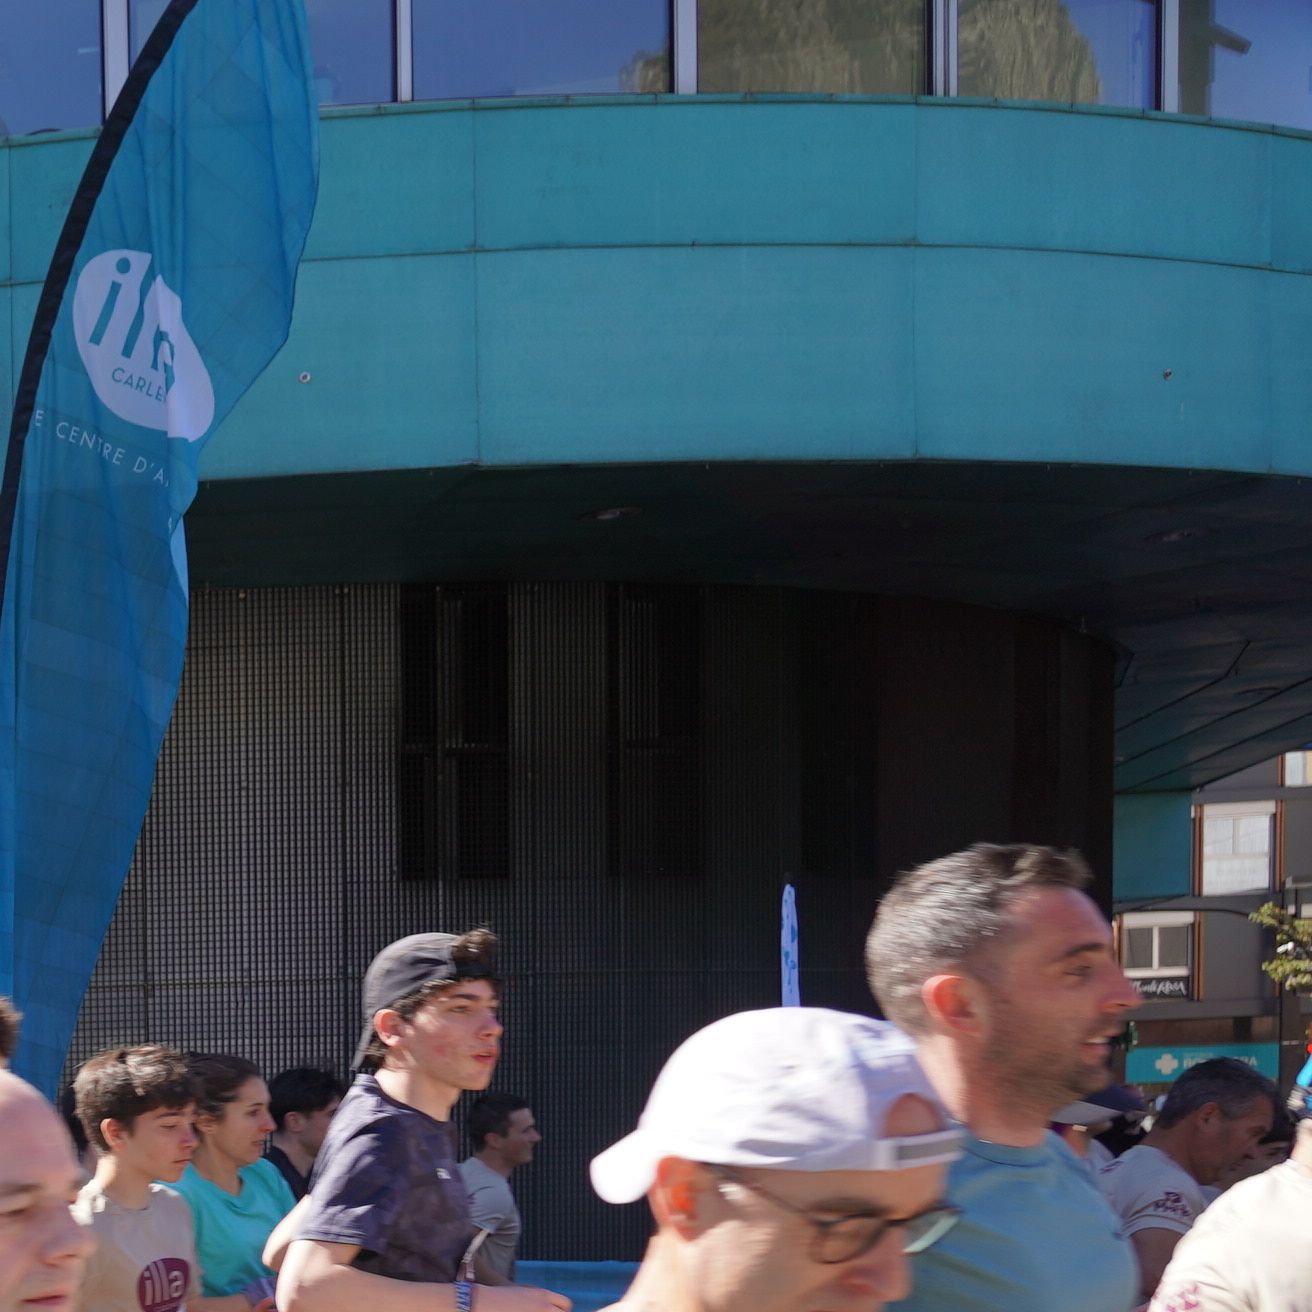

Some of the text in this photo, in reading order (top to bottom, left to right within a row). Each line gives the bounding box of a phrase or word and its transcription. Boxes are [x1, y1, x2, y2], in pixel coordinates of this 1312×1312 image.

[110, 367, 168, 404] CARLE
[55, 422, 126, 465] CENTRE
[132, 456, 170, 488] D'A
[144, 1260, 185, 1306] illa
